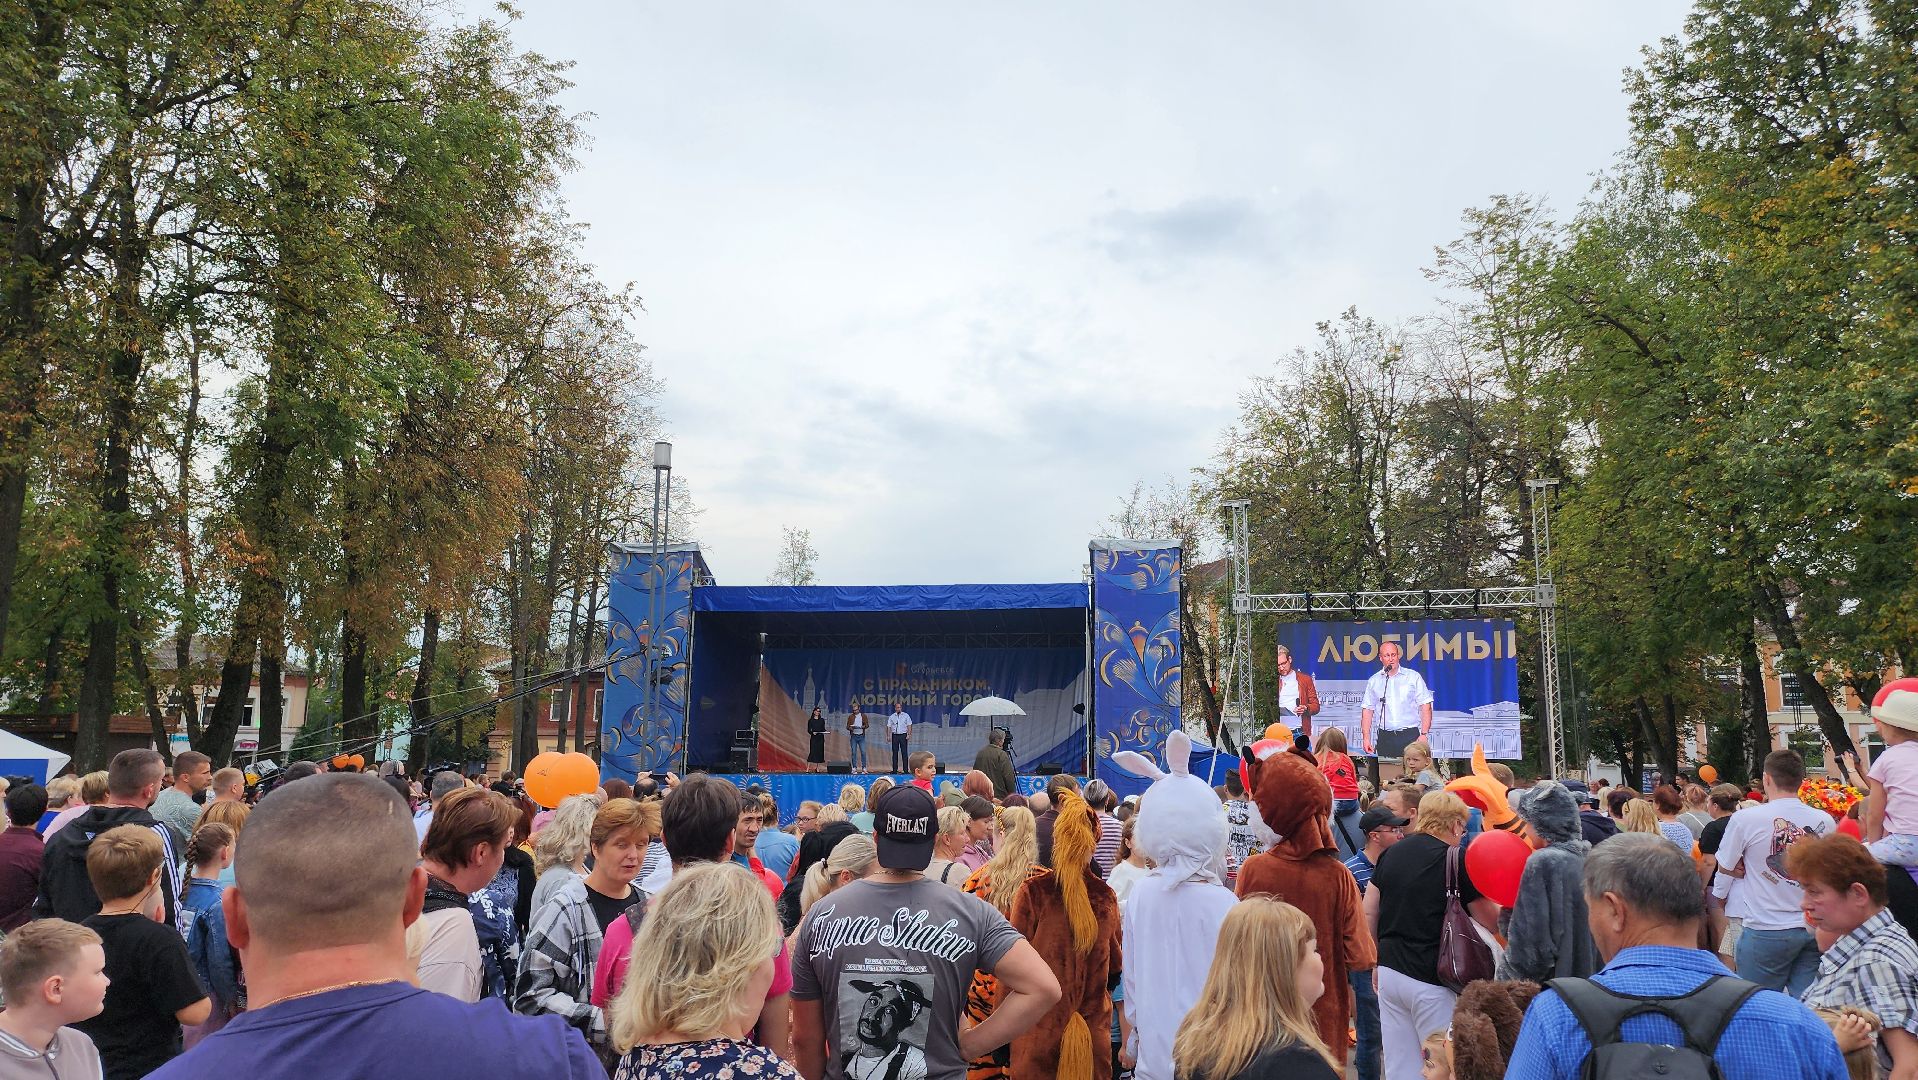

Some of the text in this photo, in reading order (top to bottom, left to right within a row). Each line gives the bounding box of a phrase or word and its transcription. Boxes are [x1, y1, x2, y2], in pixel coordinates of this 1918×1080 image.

[864, 680, 873, 691] С
[850, 690, 936, 706] ЛЮБИМЫЙ
[886, 813, 929, 835] EVERLAST
[810, 904, 976, 963] Tupac Shakur
